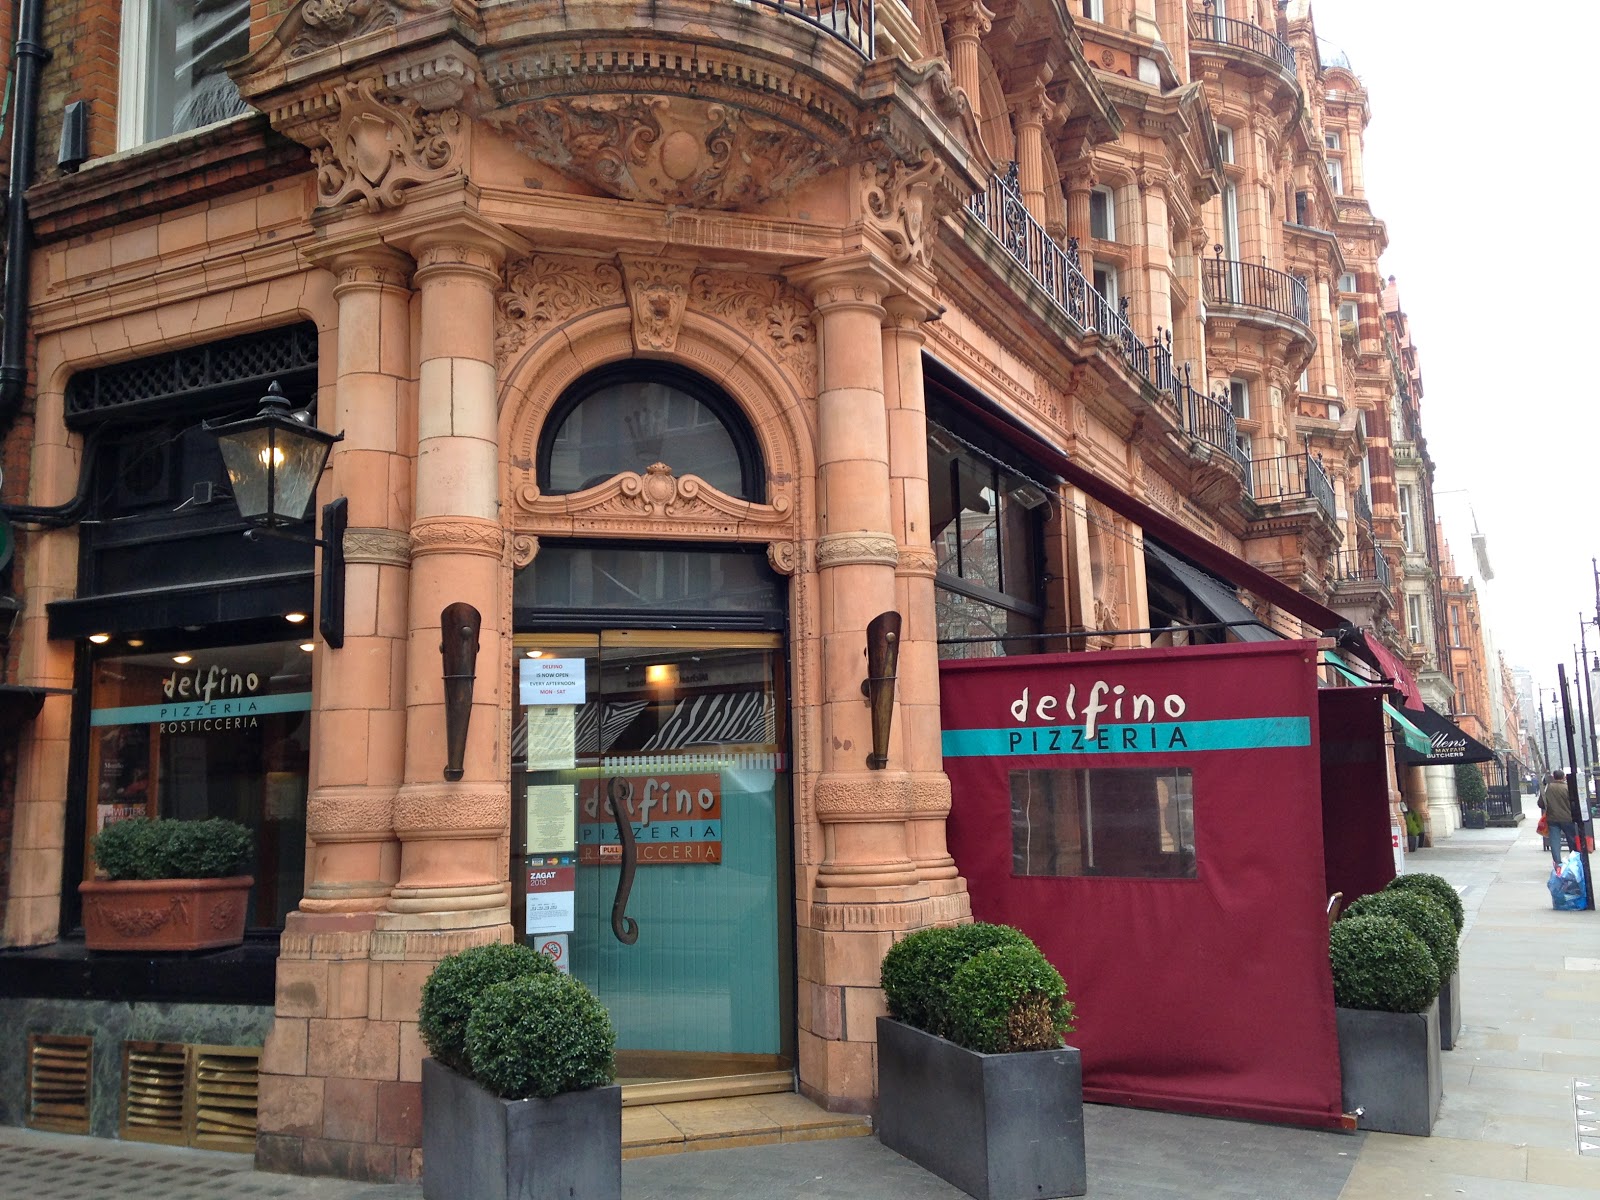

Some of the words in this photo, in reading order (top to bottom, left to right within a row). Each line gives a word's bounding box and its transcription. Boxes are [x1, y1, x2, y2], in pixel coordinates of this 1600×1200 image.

[163, 664, 259, 705] delfino
[160, 702, 257, 718] PIZZERIA
[1010, 680, 1187, 741] delfino
[160, 717, 258, 734] ROSTICCERIA
[1009, 726, 1188, 752] PIZZERIA
[585, 846, 716, 860] RICCERIA
[530, 872, 556, 880] ZAGAT
